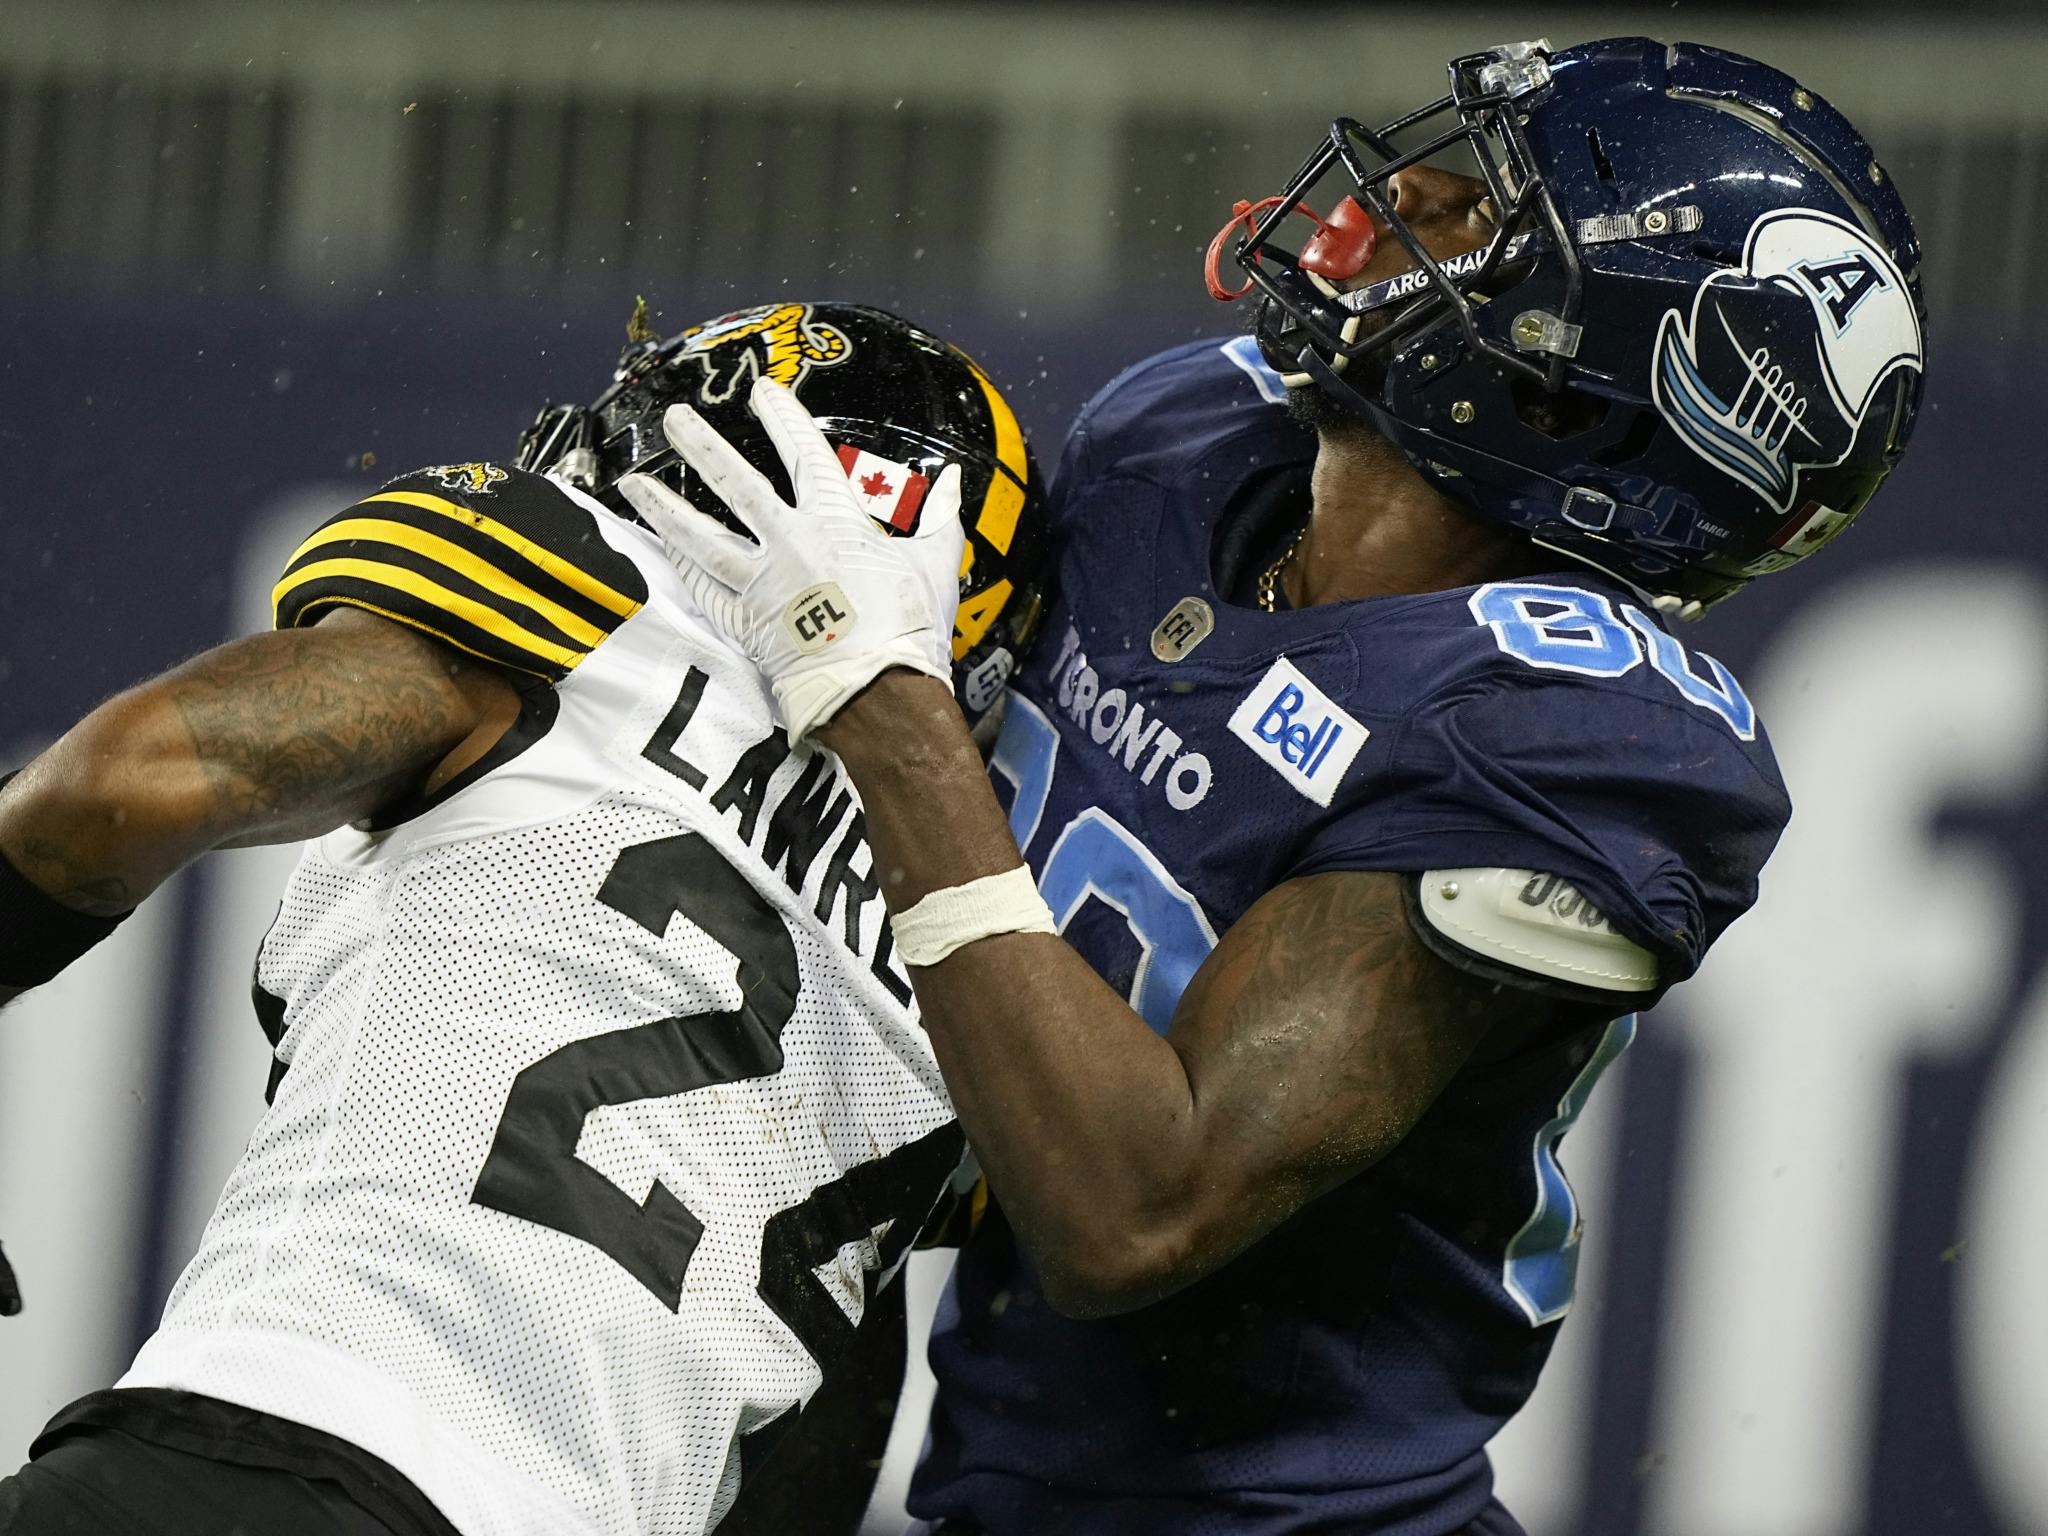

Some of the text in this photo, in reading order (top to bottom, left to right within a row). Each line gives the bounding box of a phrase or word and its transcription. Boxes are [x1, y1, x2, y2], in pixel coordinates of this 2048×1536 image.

[1386, 236, 1518, 300] ARGNAUS
[1788, 250, 1892, 339] A
[1696, 518, 1731, 539] LARGE
[795, 598, 846, 642] CFL
[1162, 612, 1197, 651] CFL
[1049, 624, 1212, 811] TORONTO
[1252, 682, 1344, 780] Bell
